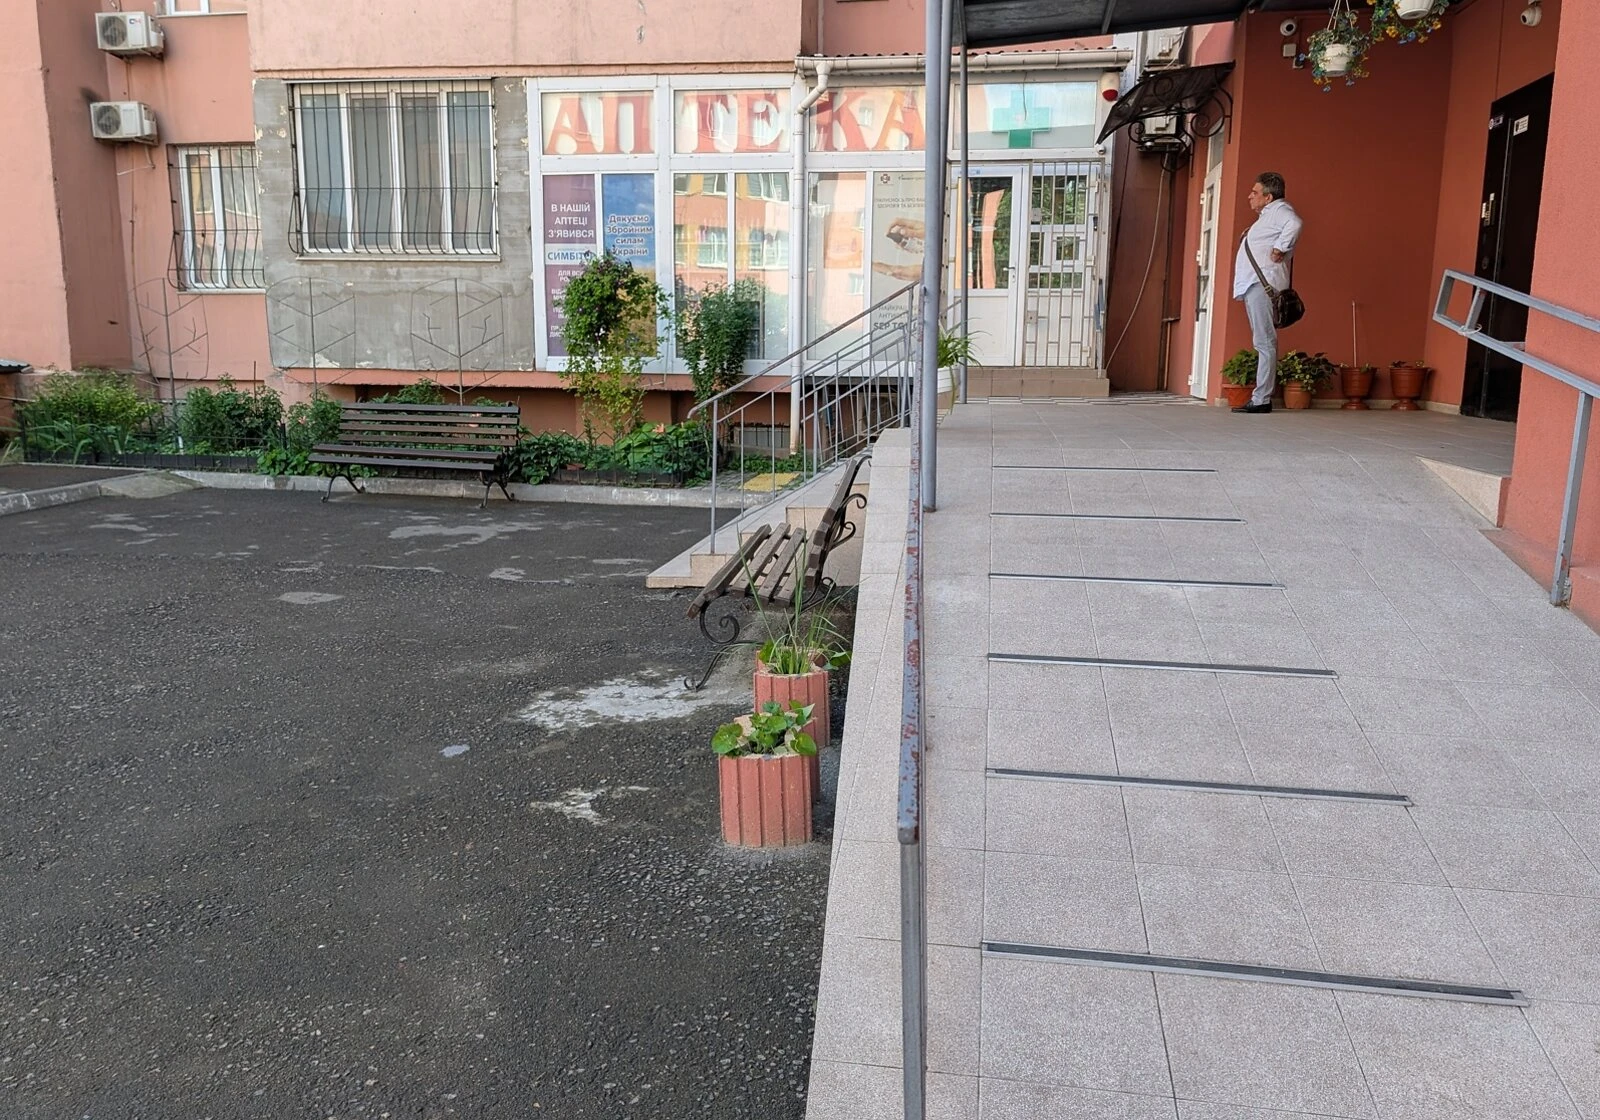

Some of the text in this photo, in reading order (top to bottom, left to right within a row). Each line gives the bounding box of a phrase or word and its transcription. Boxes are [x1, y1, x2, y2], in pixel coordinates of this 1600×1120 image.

[545, 91, 926, 153] АПТЕКА
[551, 202, 591, 212] В НАШІЙ
[554, 217, 588, 226] АПТЕЦІ
[608, 214, 650, 223] Дякуємо
[548, 229, 594, 238] З'ЯВИВСЯ
[607, 225, 653, 234] Збройним
